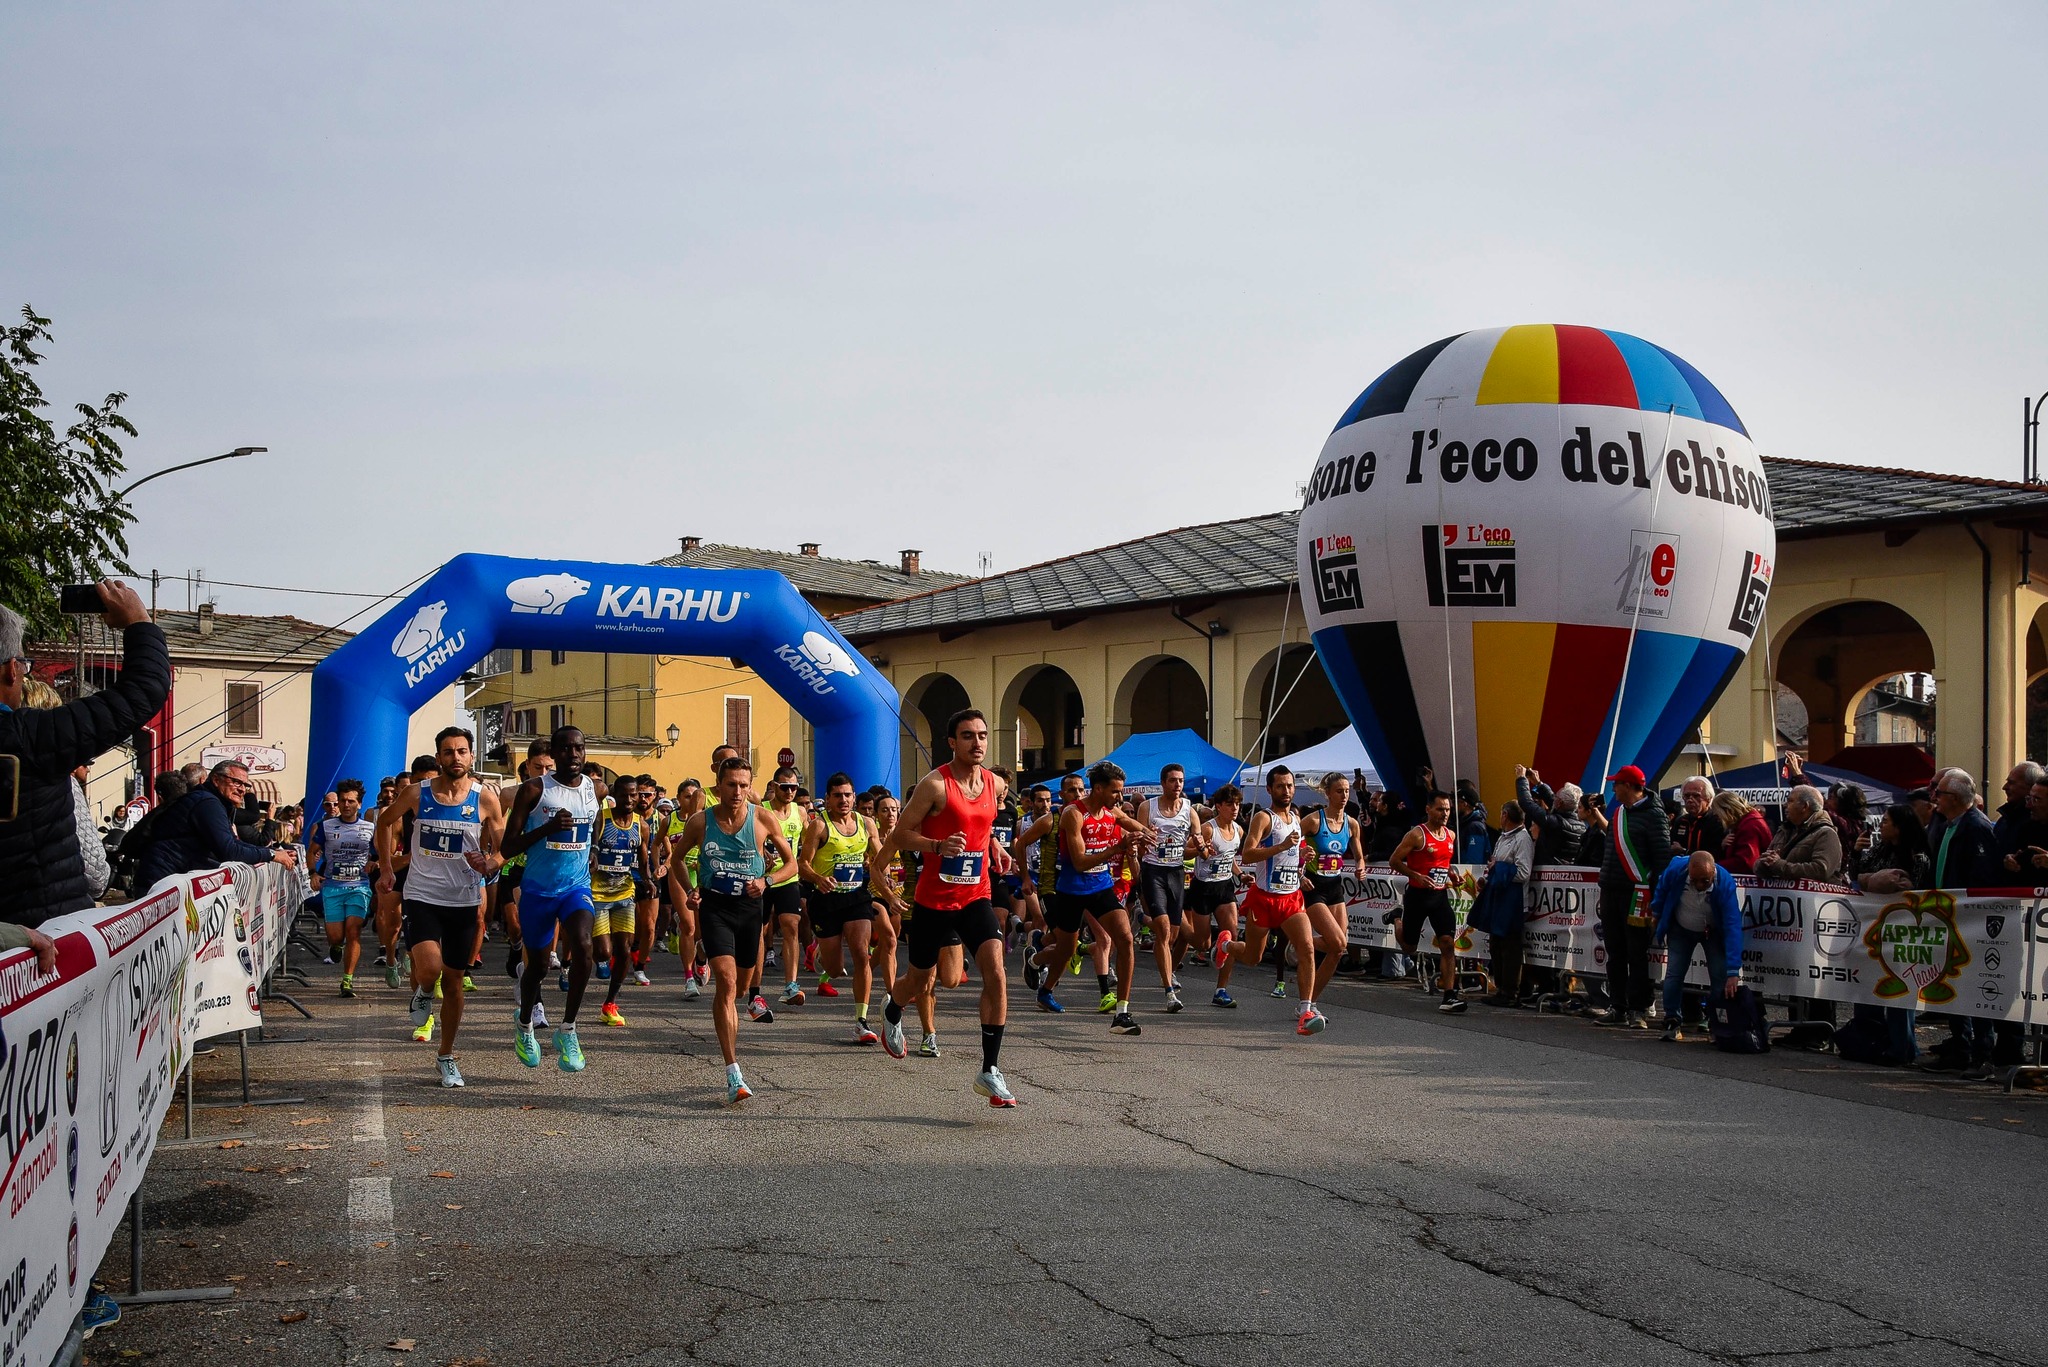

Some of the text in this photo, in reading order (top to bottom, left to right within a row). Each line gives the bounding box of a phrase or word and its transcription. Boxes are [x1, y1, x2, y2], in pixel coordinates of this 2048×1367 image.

[1561, 427, 1651, 489] del
[1467, 524, 1511, 542] L'eco
[595, 584, 742, 623] KARHU
[595, 622, 664, 633] www.karhu.com
[404, 632, 466, 688] KARHU
[774, 644, 834, 695] KARHU
[219, 746, 268, 755] TRATTORIA
[571, 826, 578, 842] 1
[1000, 831, 1006, 842] 8
[439, 836, 450, 851] 4
[615, 855, 623, 867] 2
[1331, 859, 1338, 870] 9
[338, 867, 360, 876] 340
[962, 860, 974, 876] 5
[848, 869, 857, 882] 7
[1279, 872, 1298, 884] 439
[1541, 872, 1583, 881] AUTORIZZATA
[731, 881, 744, 896] 3
[1761, 879, 1796, 889] TORINO
[1798, 880, 1806, 890] E
[1963, 903, 2025, 912] STELLANTIS
[1347, 915, 1373, 925] CAVOUR
[1816, 921, 1858, 934] DFSK
[1525, 931, 1558, 943] CAVOUR
[1752, 929, 1804, 942] automobili
[1882, 924, 1947, 946] APPLE
[1893, 944, 1933, 965] RUN
[1755, 965, 1800, 977] 0121/600.233
[1809, 965, 1861, 983] DFSK
[1902, 962, 1942, 988] Team
[2021, 991, 2037, 1000] Via
[11, 1122, 58, 1220] automobili
[96, 1151, 122, 1218] HONDA
[0, 1257, 26, 1327] OUR
